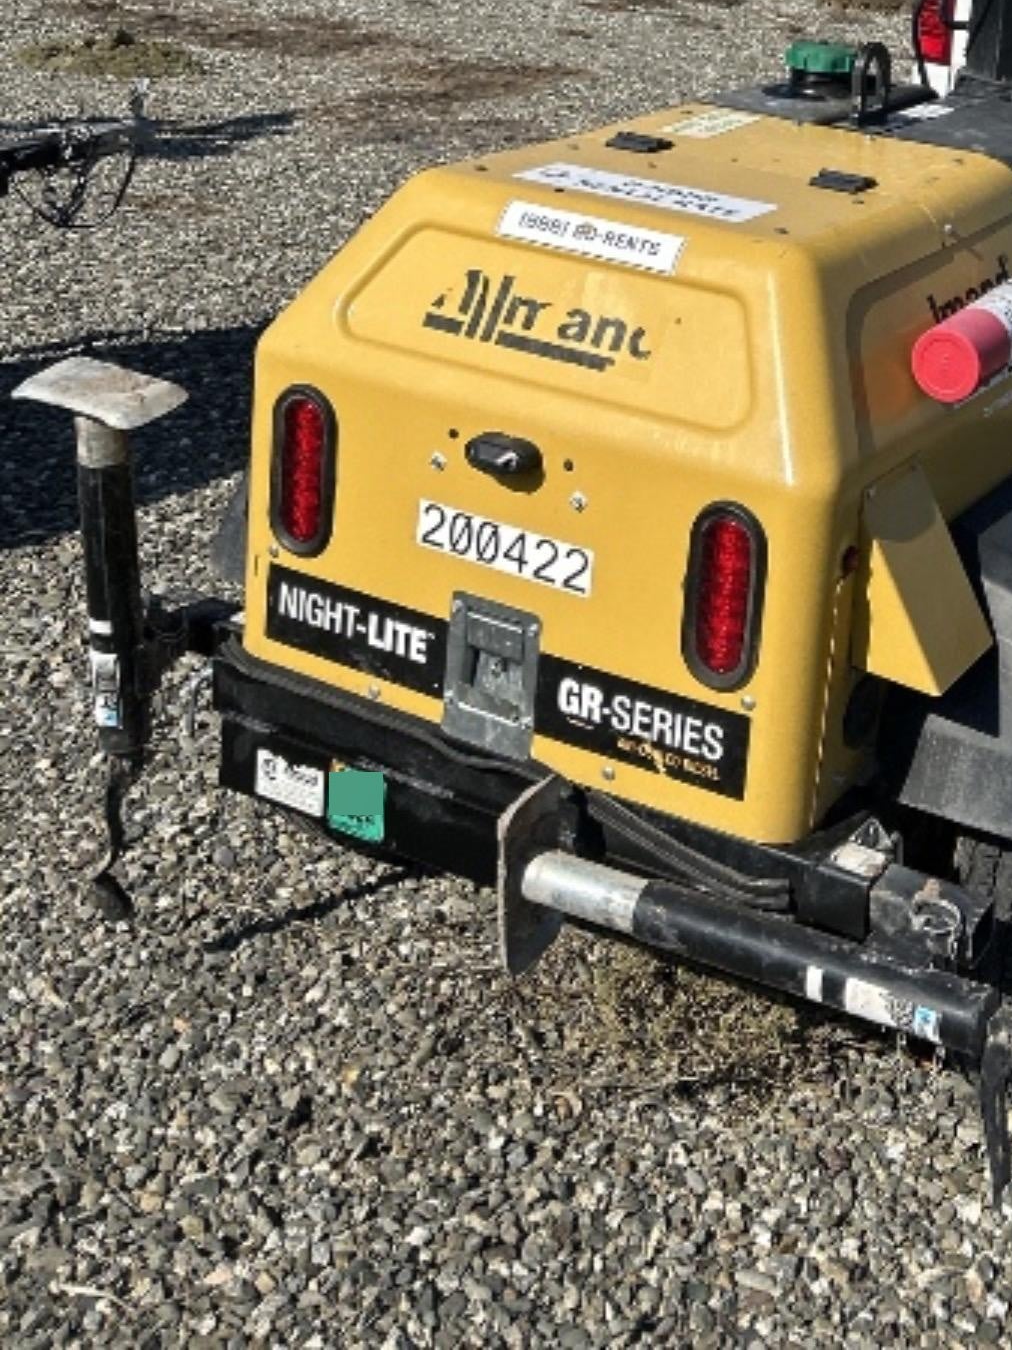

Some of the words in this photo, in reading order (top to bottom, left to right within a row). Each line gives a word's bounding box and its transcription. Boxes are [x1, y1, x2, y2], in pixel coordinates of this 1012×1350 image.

[421, 503, 589, 594] 200422
[278, 581, 429, 664] NIGHT-LITE
[557, 677, 724, 761] GR-SERIES
